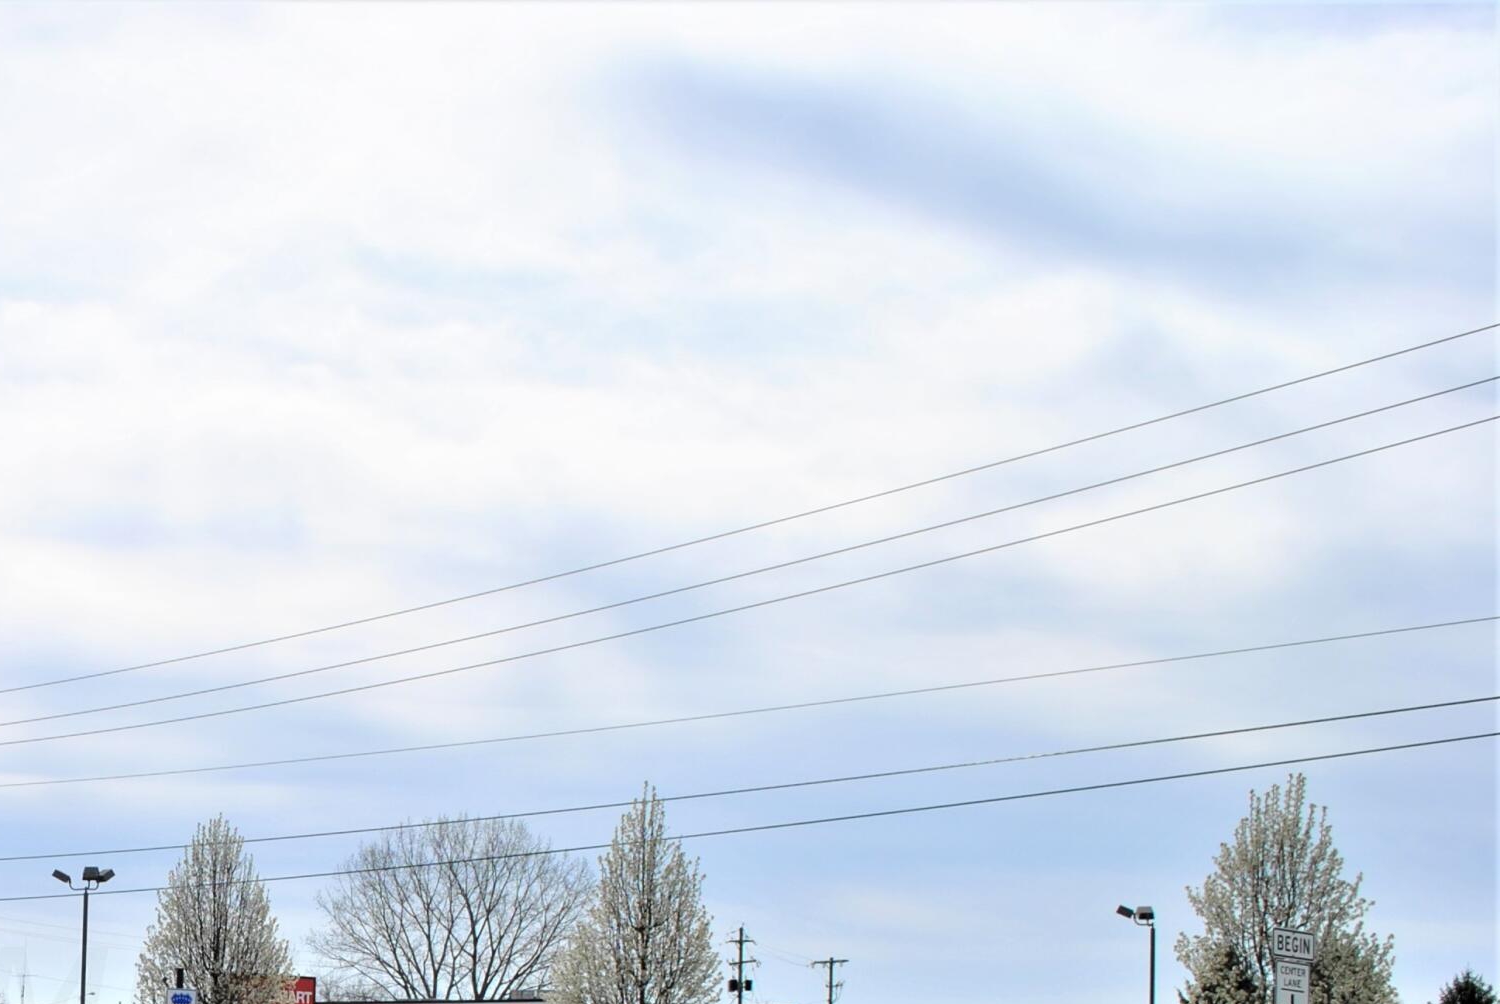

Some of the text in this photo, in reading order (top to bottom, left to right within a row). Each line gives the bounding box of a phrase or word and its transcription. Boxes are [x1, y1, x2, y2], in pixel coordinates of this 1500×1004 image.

[1277, 934, 1311, 955] BEGIN
[1280, 965, 1306, 977] CENTER
[1283, 978, 1302, 988] LANE
